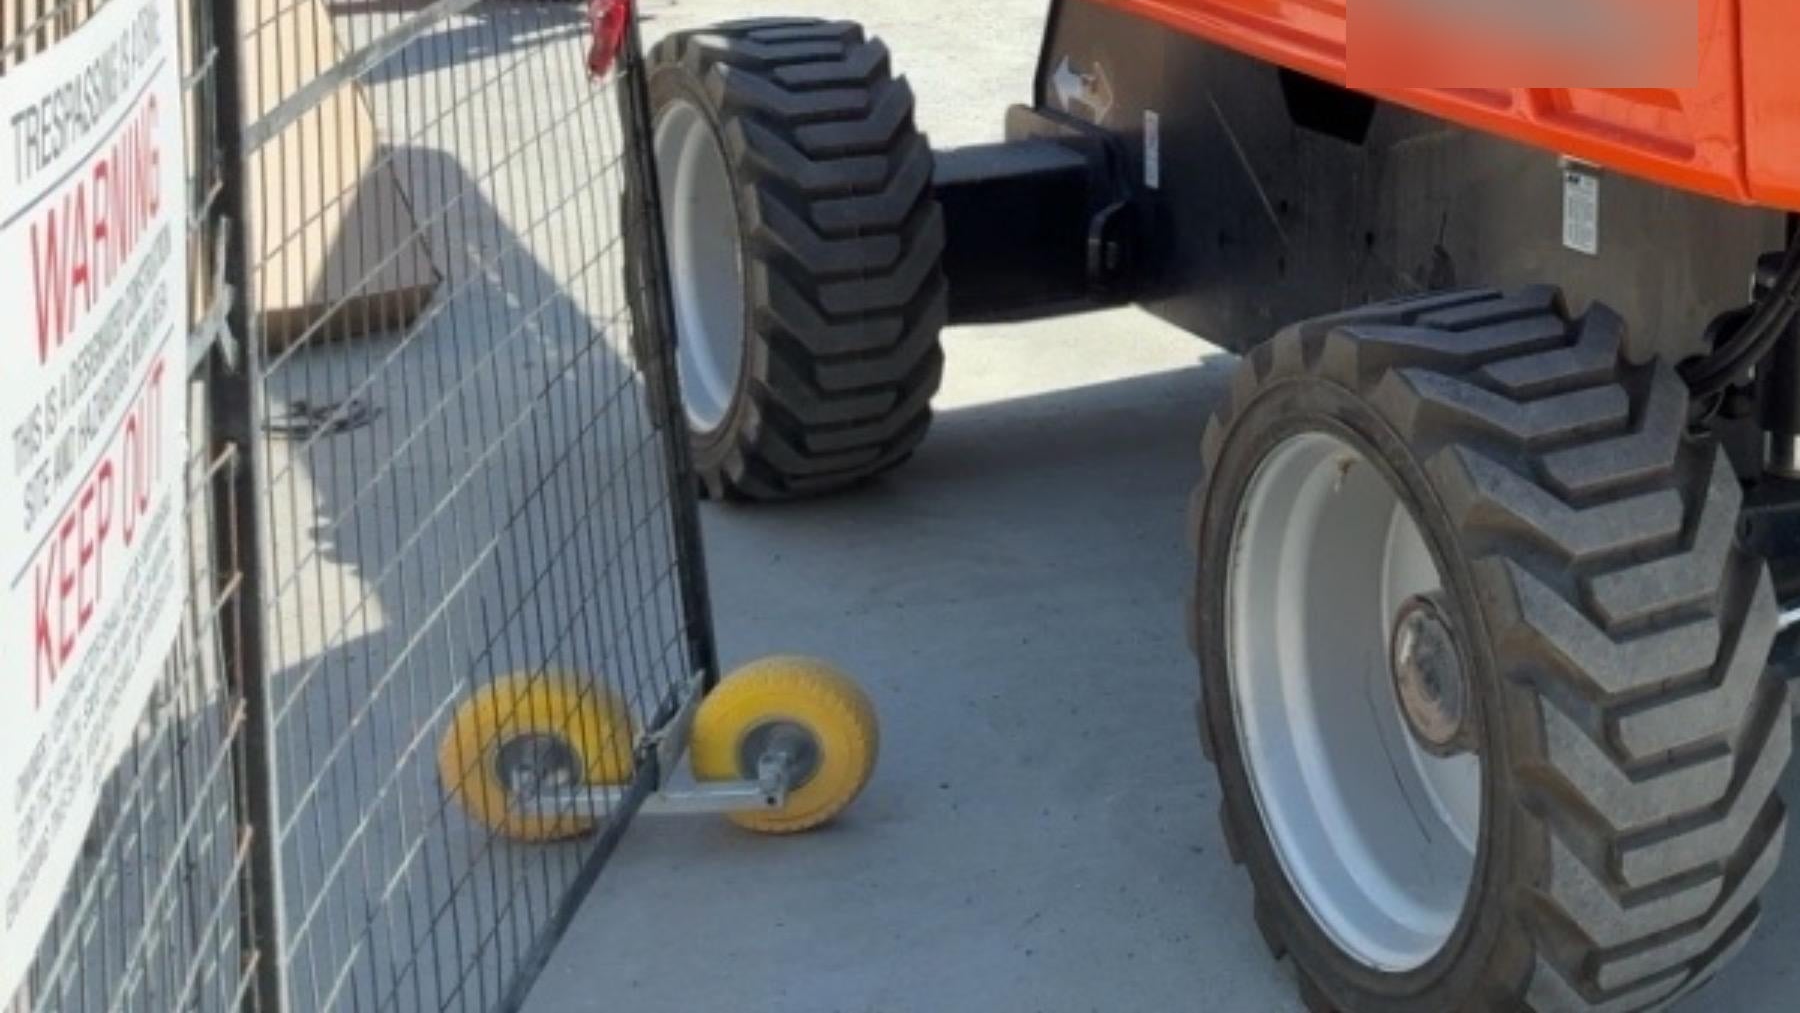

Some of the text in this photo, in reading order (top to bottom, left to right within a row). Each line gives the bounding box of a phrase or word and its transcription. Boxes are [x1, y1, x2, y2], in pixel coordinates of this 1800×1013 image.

[30, 92, 161, 367] WARNING
[34, 459, 113, 712] KEEP
[122, 358, 166, 548] OUT
